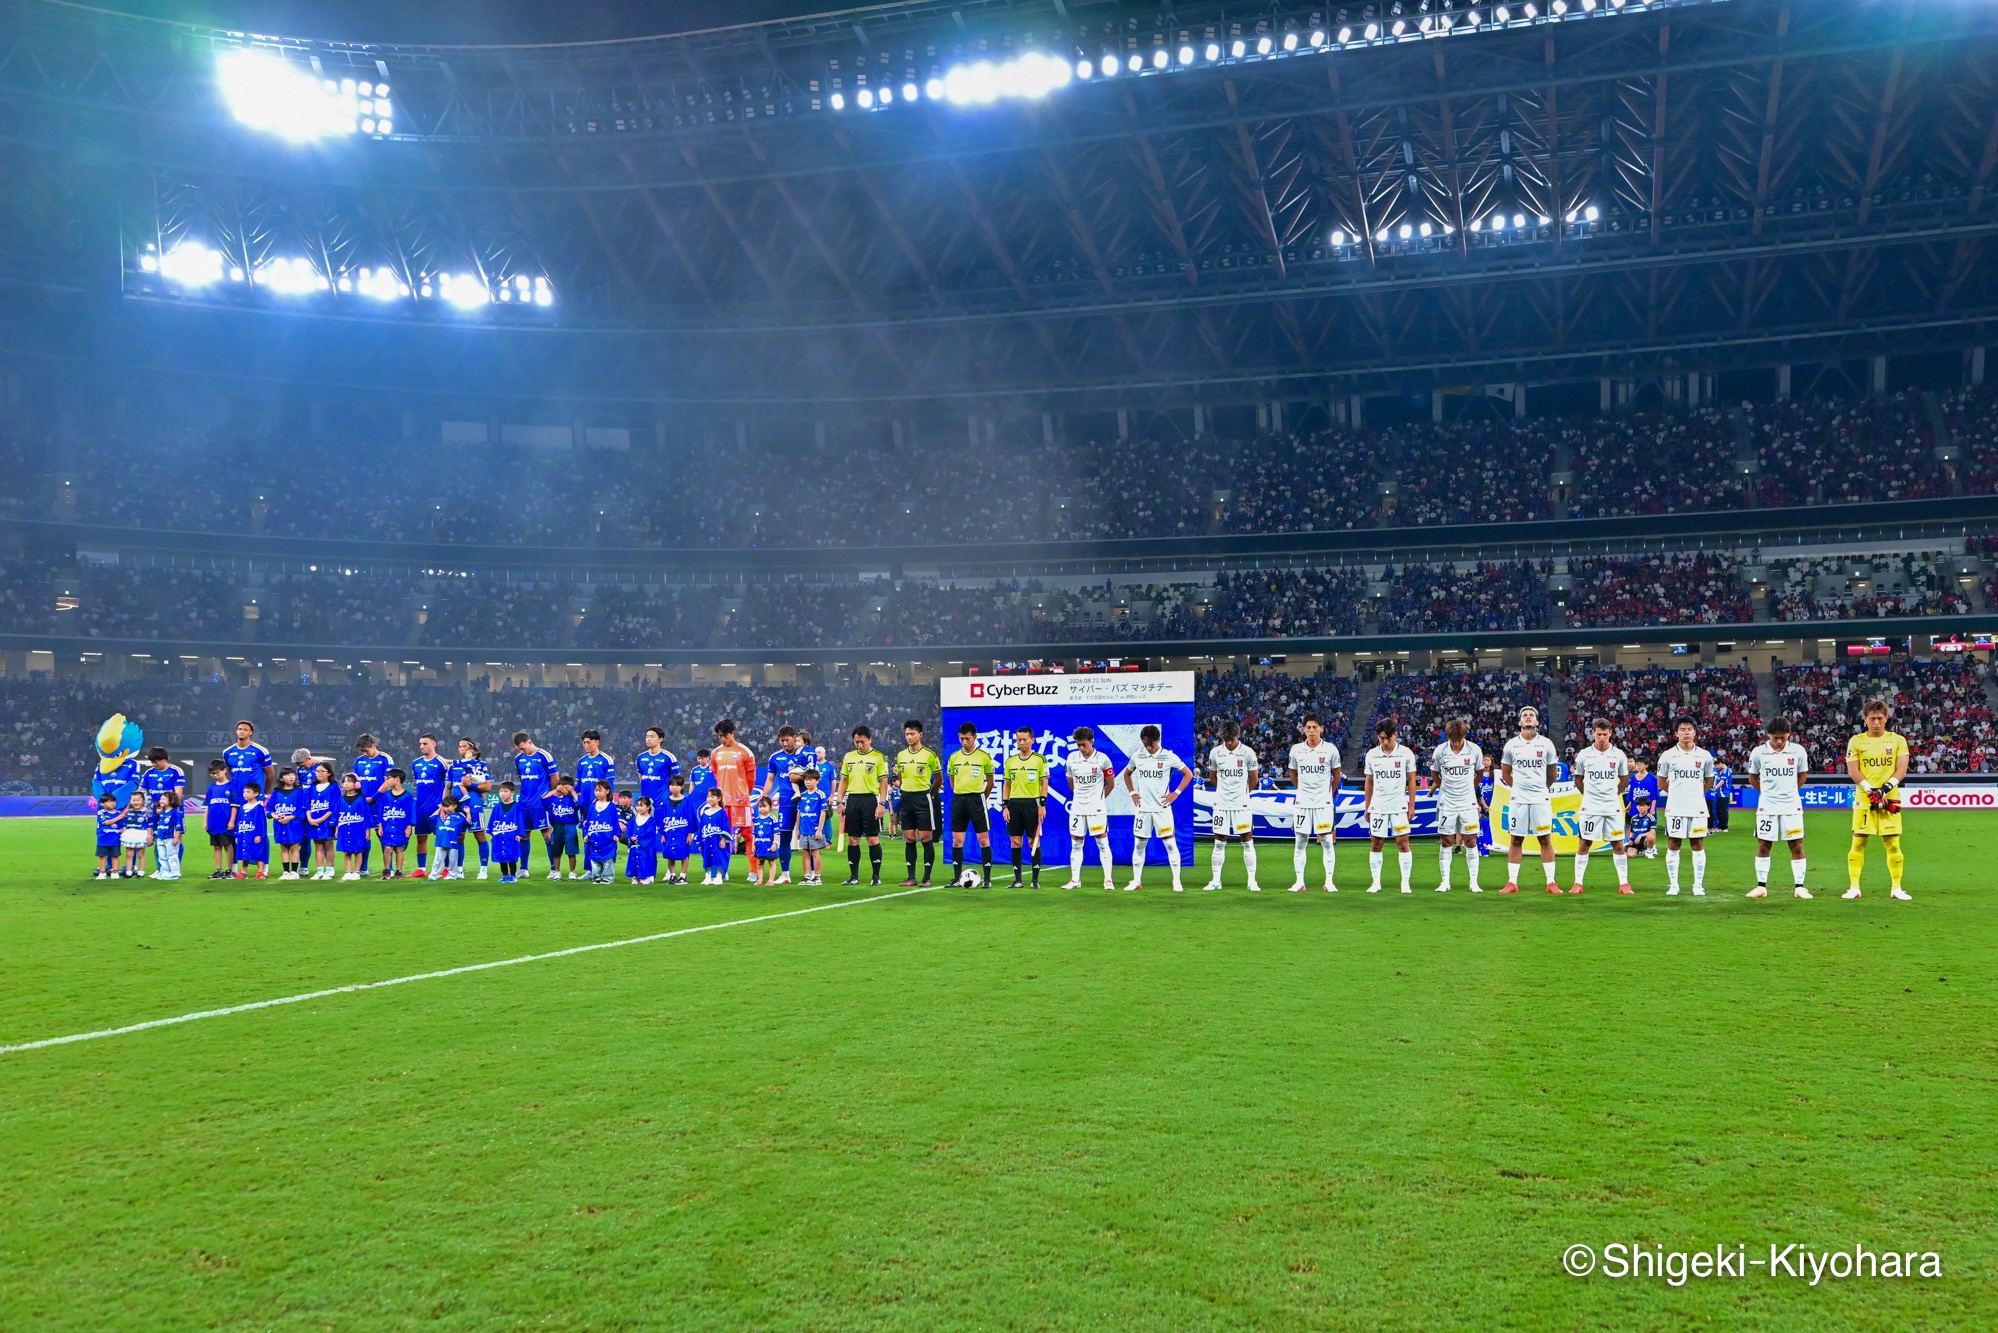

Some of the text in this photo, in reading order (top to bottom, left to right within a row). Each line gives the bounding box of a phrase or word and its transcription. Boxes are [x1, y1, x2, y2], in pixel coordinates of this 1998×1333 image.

[986, 683, 1058, 700] CyberBuzz
[1131, 682, 1173, 692] マッチデー
[1516, 759, 1542, 768] POLUS
[1862, 757, 1893, 768] POLUS
[1139, 770, 1163, 778] POLUS
[1300, 765, 1325, 774] POLUS
[1375, 770, 1401, 779] POLUS
[1674, 770, 1700, 779] POLUS
[1765, 767, 1794, 776] POLUS
[1588, 771, 1615, 780] POLUS
[1909, 789, 1995, 806] docomo
[338, 812, 364, 827] Zelvia
[1073, 817, 1079, 828] 2
[1135, 819, 1143, 829] 13
[1213, 815, 1224, 827] 88
[1296, 815, 1306, 826] 17
[1372, 818, 1383, 830] 37
[1441, 816, 1447, 826] 7
[1511, 817, 1517, 828] 3
[1671, 818, 1681, 830] 18
[1863, 814, 1867, 826] 1
[588, 820, 613, 836] Zelvia
[1584, 820, 1594, 832] 10
[1759, 819, 1772, 832] 25
